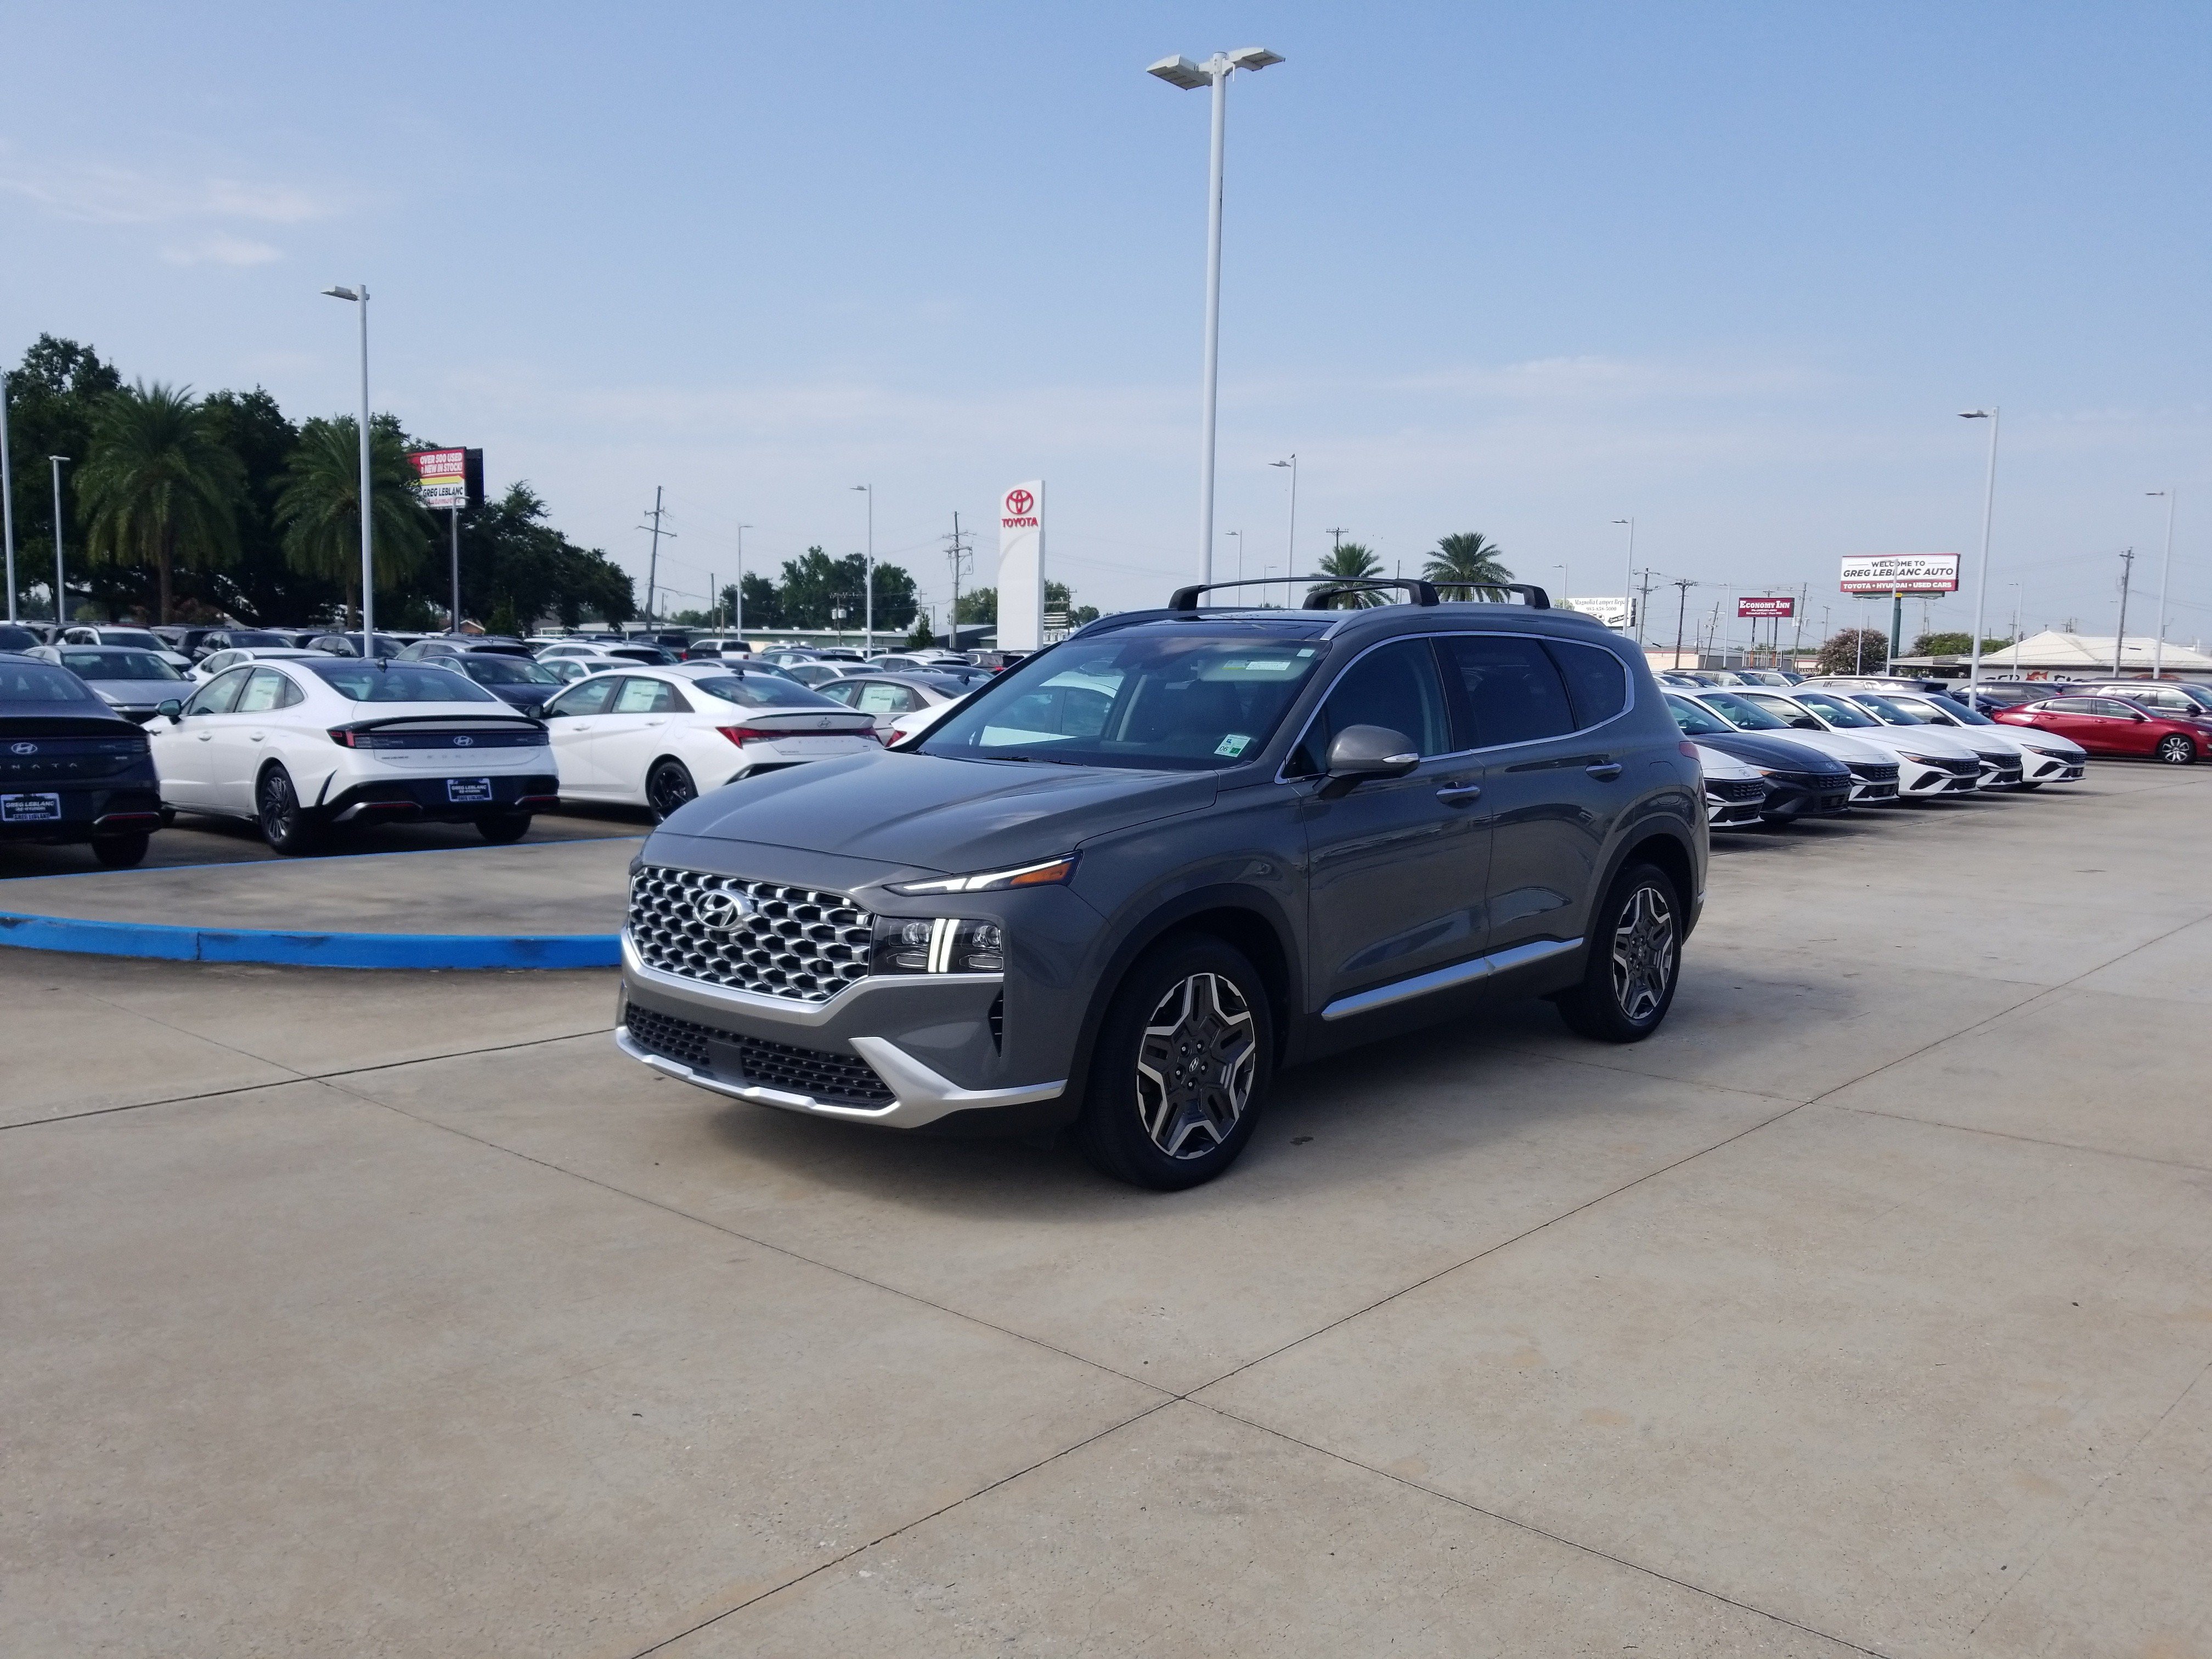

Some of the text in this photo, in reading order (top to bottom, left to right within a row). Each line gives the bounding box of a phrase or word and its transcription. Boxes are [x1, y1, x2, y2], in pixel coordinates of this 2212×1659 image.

[420, 455, 435, 465] OVER
[447, 452, 462, 462] USED
[425, 464, 437, 473] NEW
[437, 463, 443, 472] IN
[422, 487, 463, 497] GREG LEBLANC
[1001, 517, 1038, 528] TOYOTA
[1843, 569, 1871, 577] GREG
